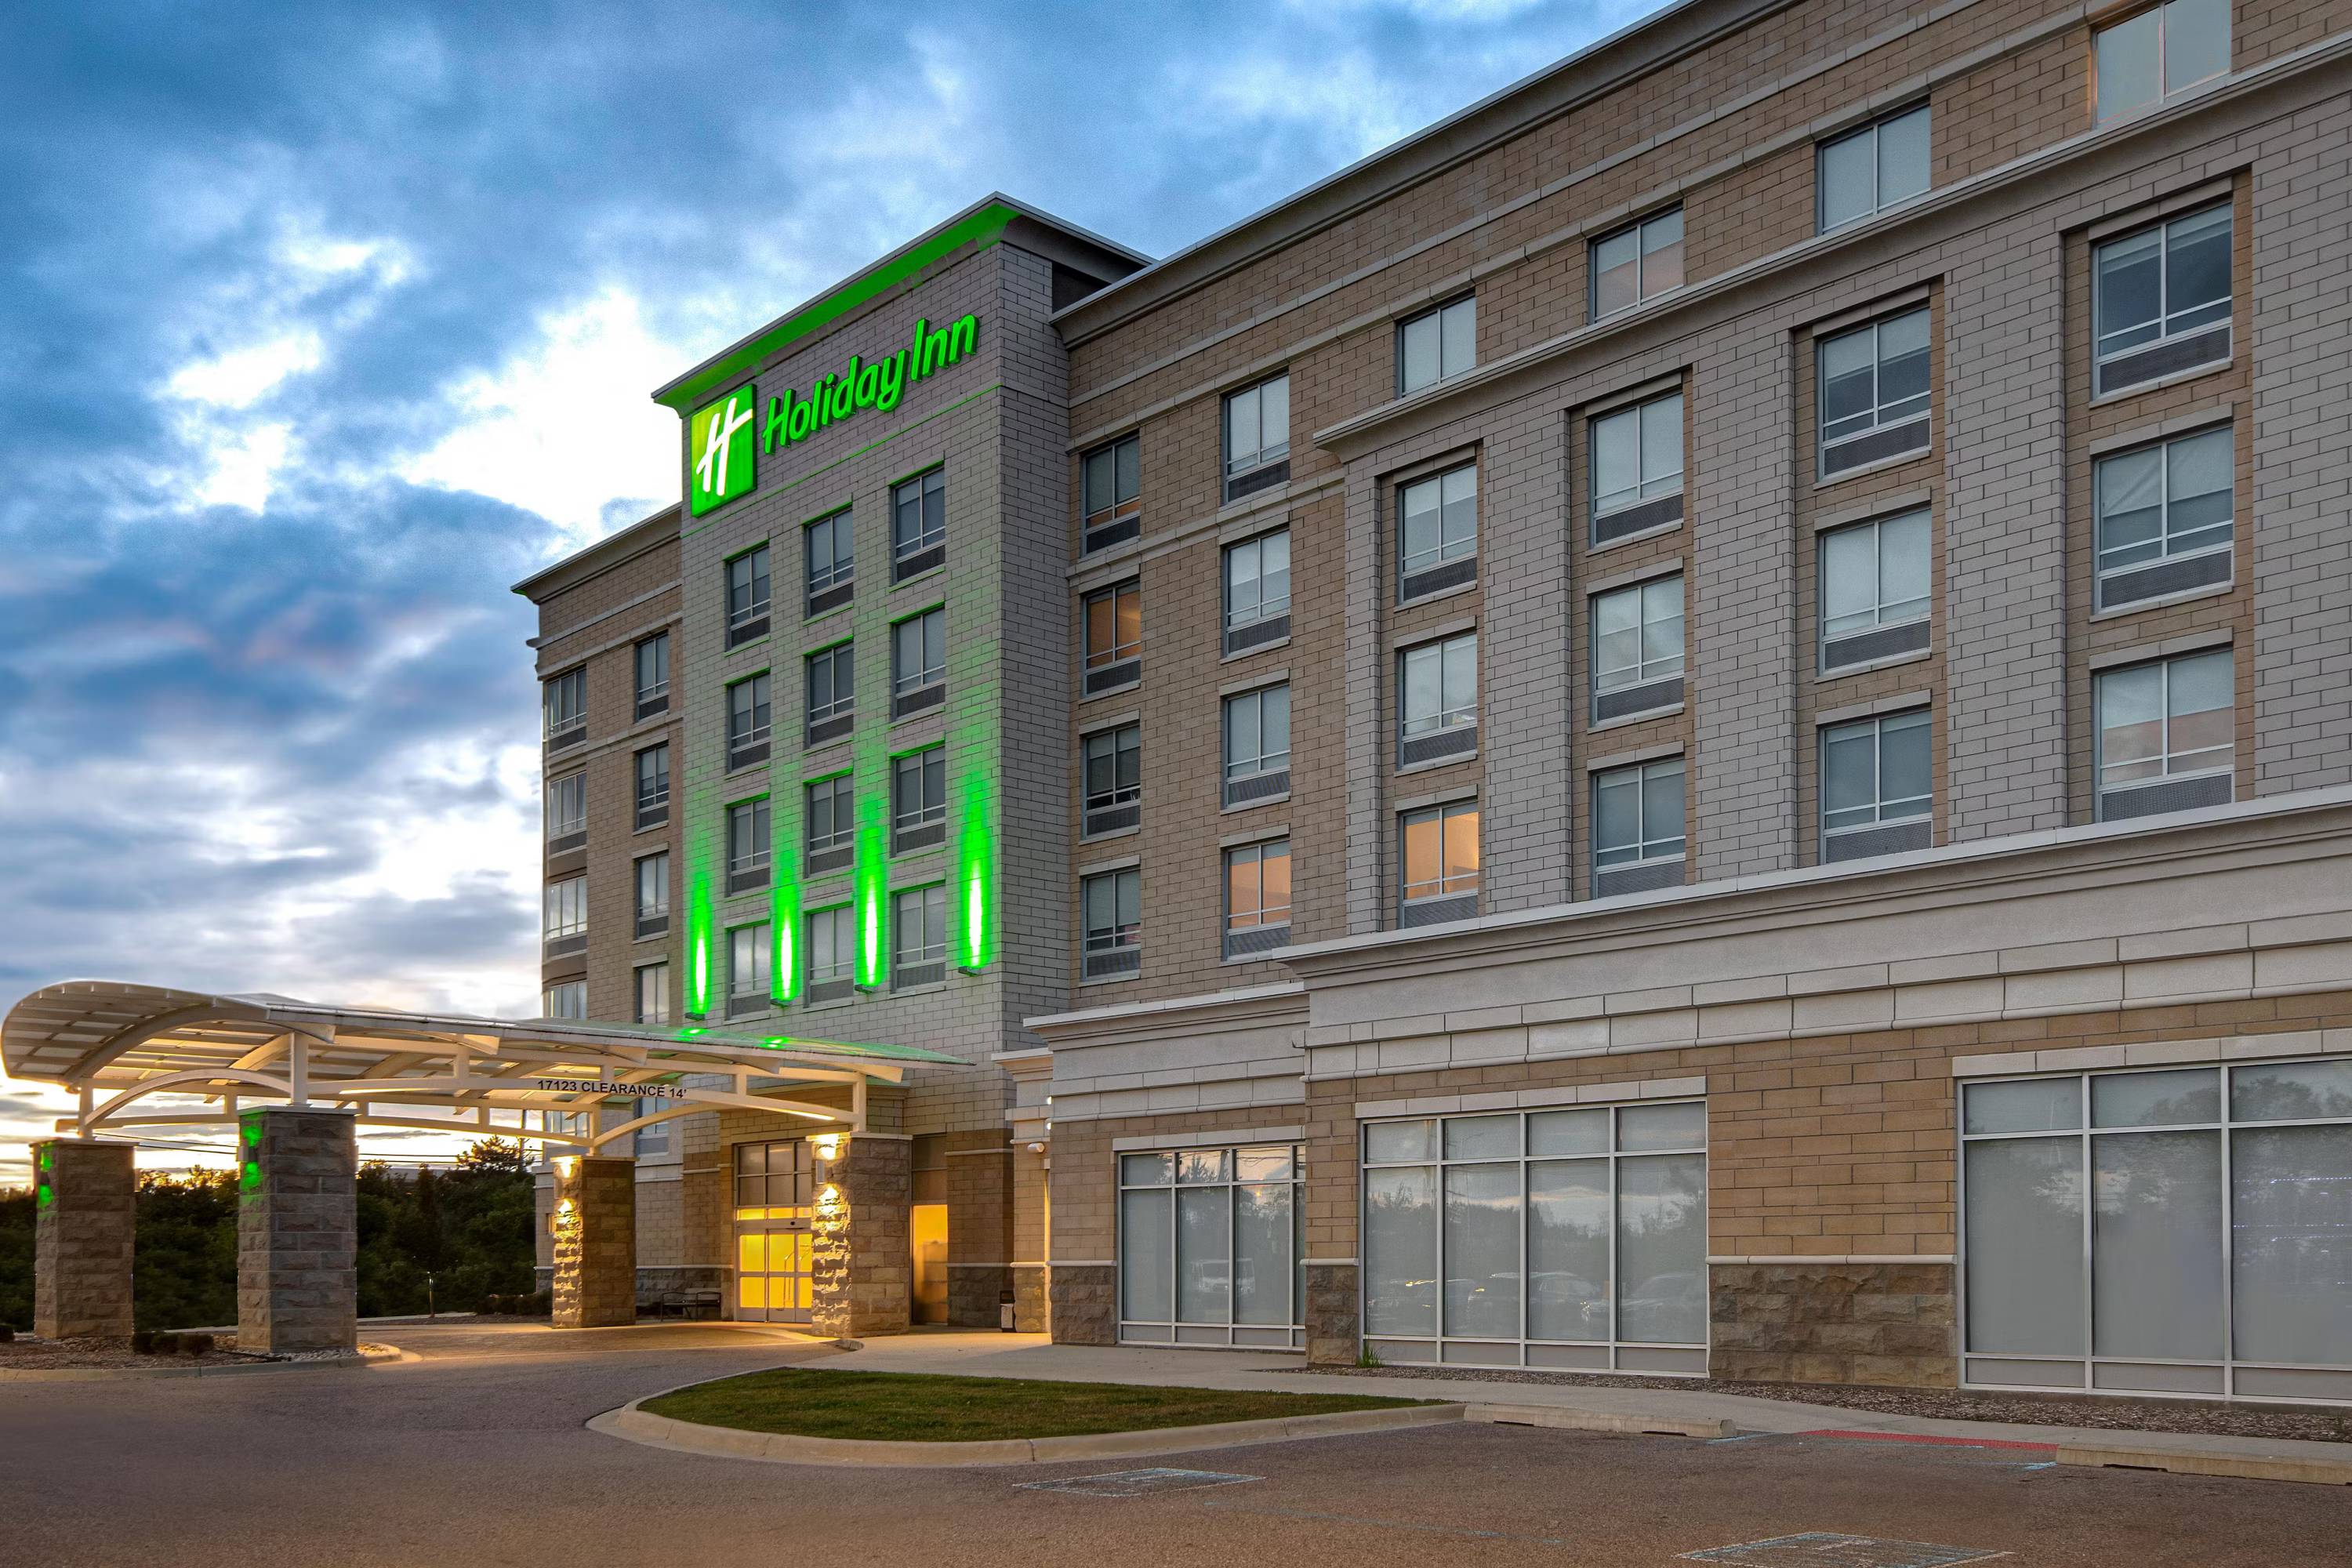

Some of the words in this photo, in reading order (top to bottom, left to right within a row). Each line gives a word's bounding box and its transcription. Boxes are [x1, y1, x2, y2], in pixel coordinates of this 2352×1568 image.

[763, 349, 909, 455] Holiday
[910, 314, 979, 382] Inn
[696, 397, 753, 496] H
[538, 1080, 577, 1091] 17123
[582, 1082, 666, 1097] CLEARANCE
